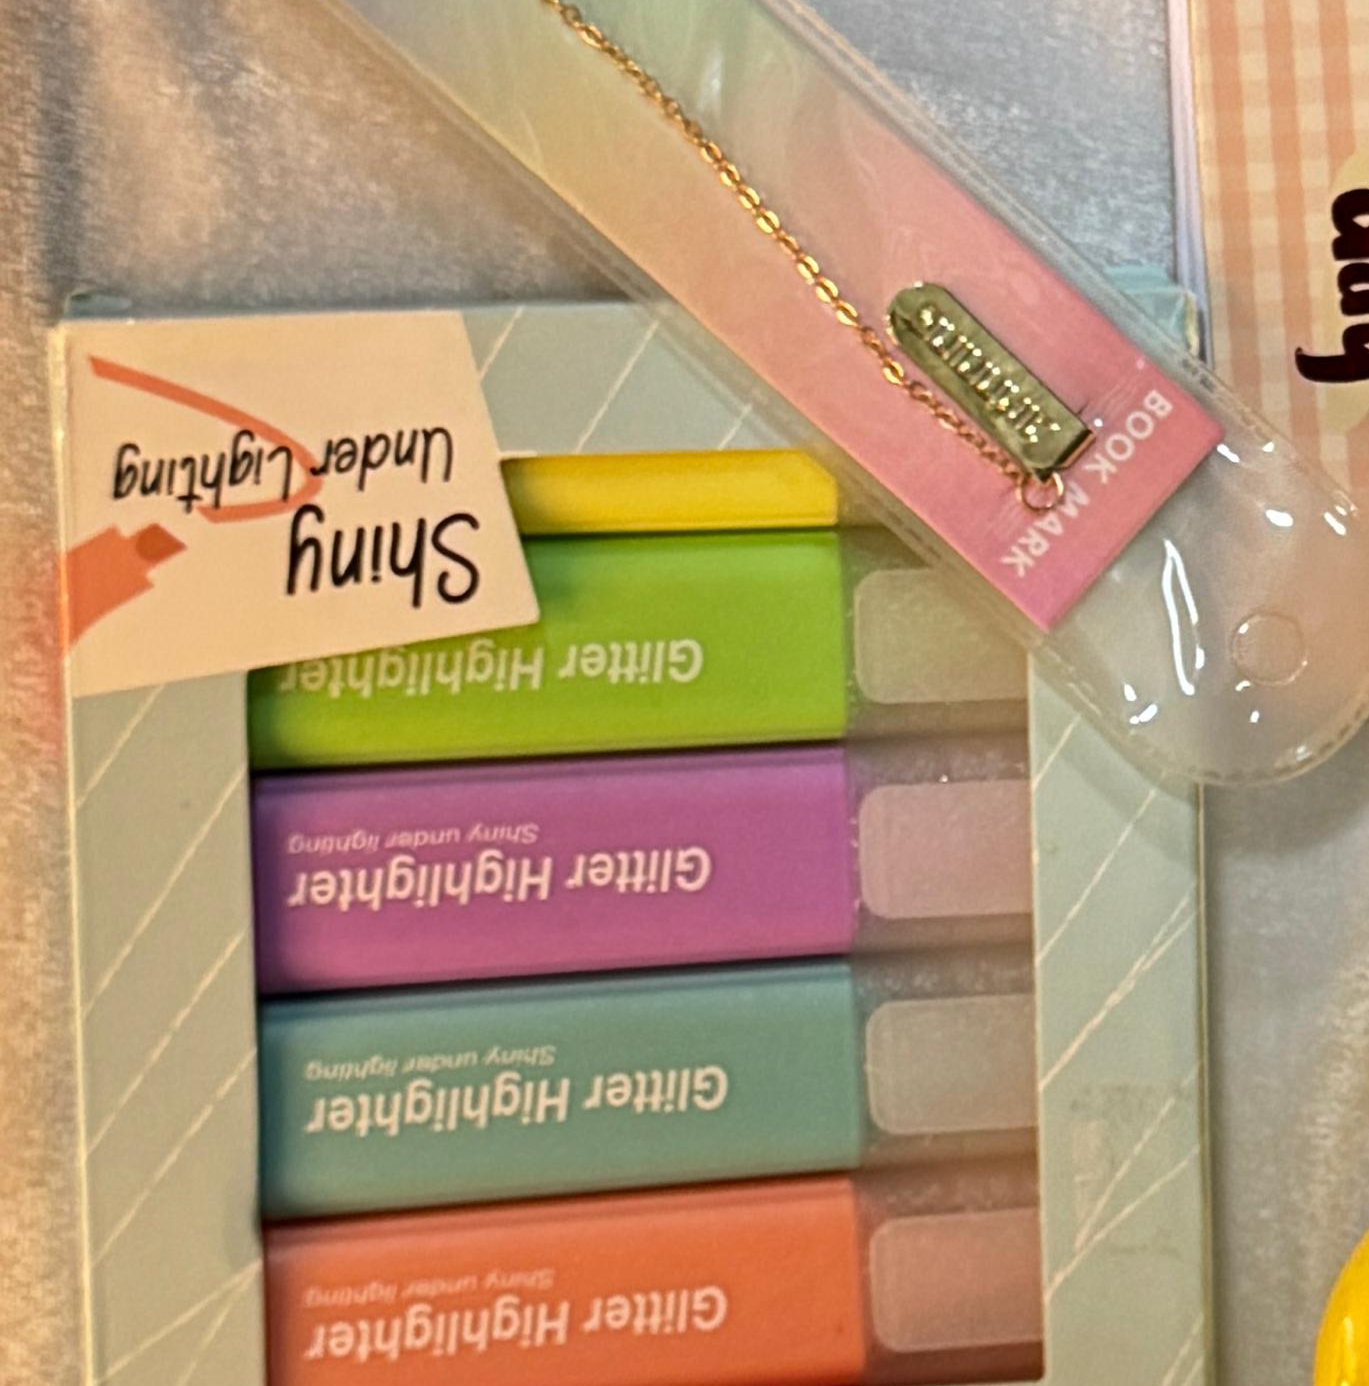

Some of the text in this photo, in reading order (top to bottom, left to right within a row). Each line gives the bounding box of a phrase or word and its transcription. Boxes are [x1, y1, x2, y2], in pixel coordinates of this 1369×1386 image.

[113, 426, 454, 514] Under Lighting
[999, 389, 1173, 578] BOOK MARK
[286, 503, 481, 609] Shiny
[276, 637, 704, 699] Glitter Highlighter
[286, 823, 540, 855] Shiny under lighting
[287, 846, 712, 912] Glitter Highlighter
[304, 1045, 557, 1082] Shiny under lighting
[305, 1065, 728, 1138] Glitter Highlighter
[304, 1285, 728, 1363] Glitter Highlighter
